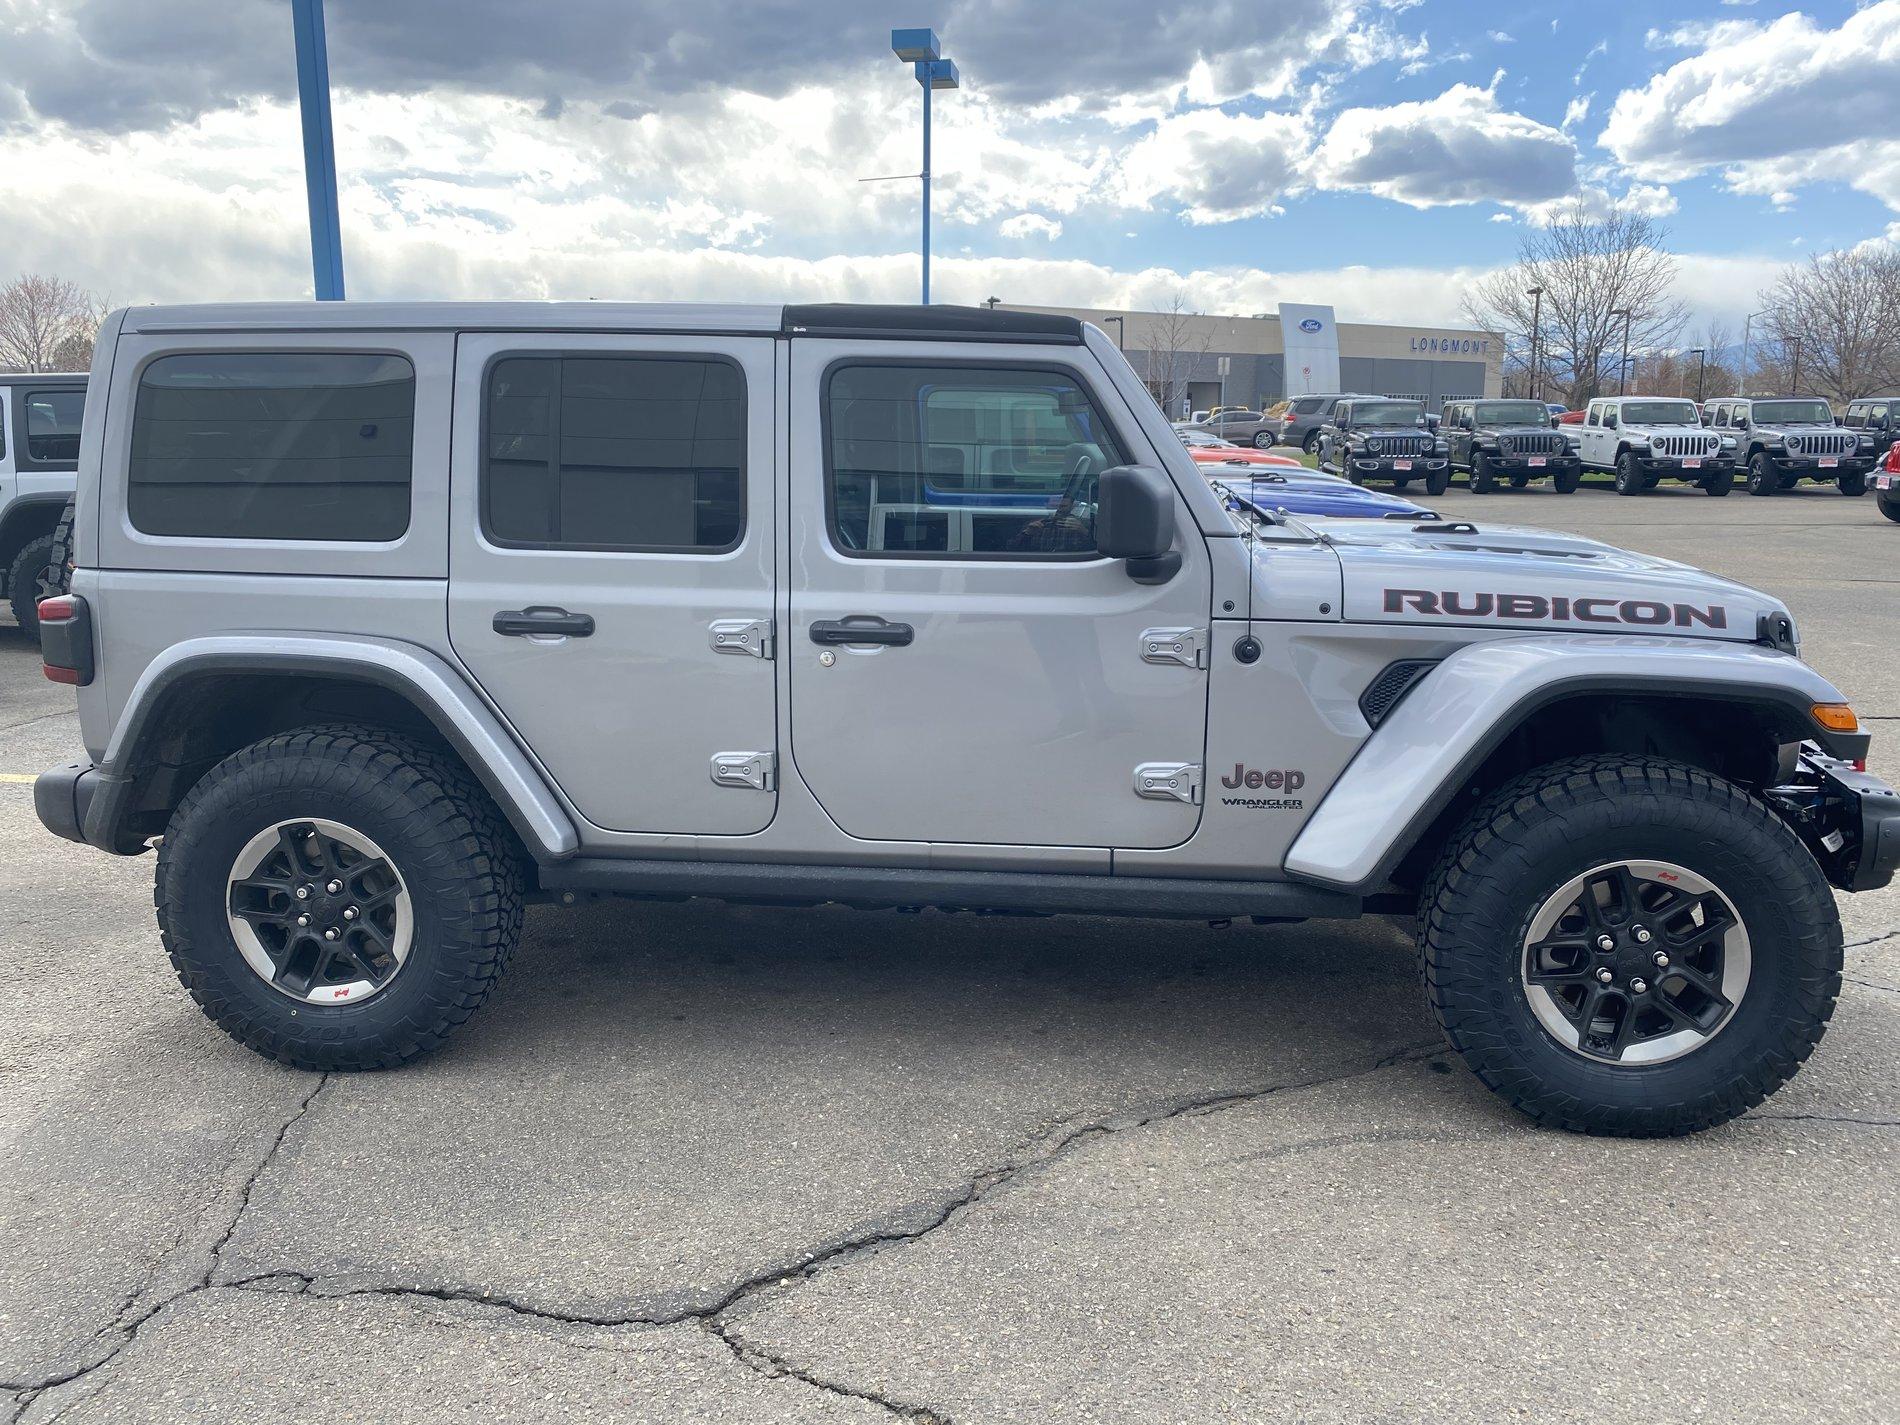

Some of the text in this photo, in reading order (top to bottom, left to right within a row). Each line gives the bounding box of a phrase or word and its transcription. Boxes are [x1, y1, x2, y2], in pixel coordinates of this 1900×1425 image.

[1411, 337, 1489, 354] LONGMONT
[1383, 588, 1727, 629] RUBICON
[1222, 763, 1305, 794] Jeep
